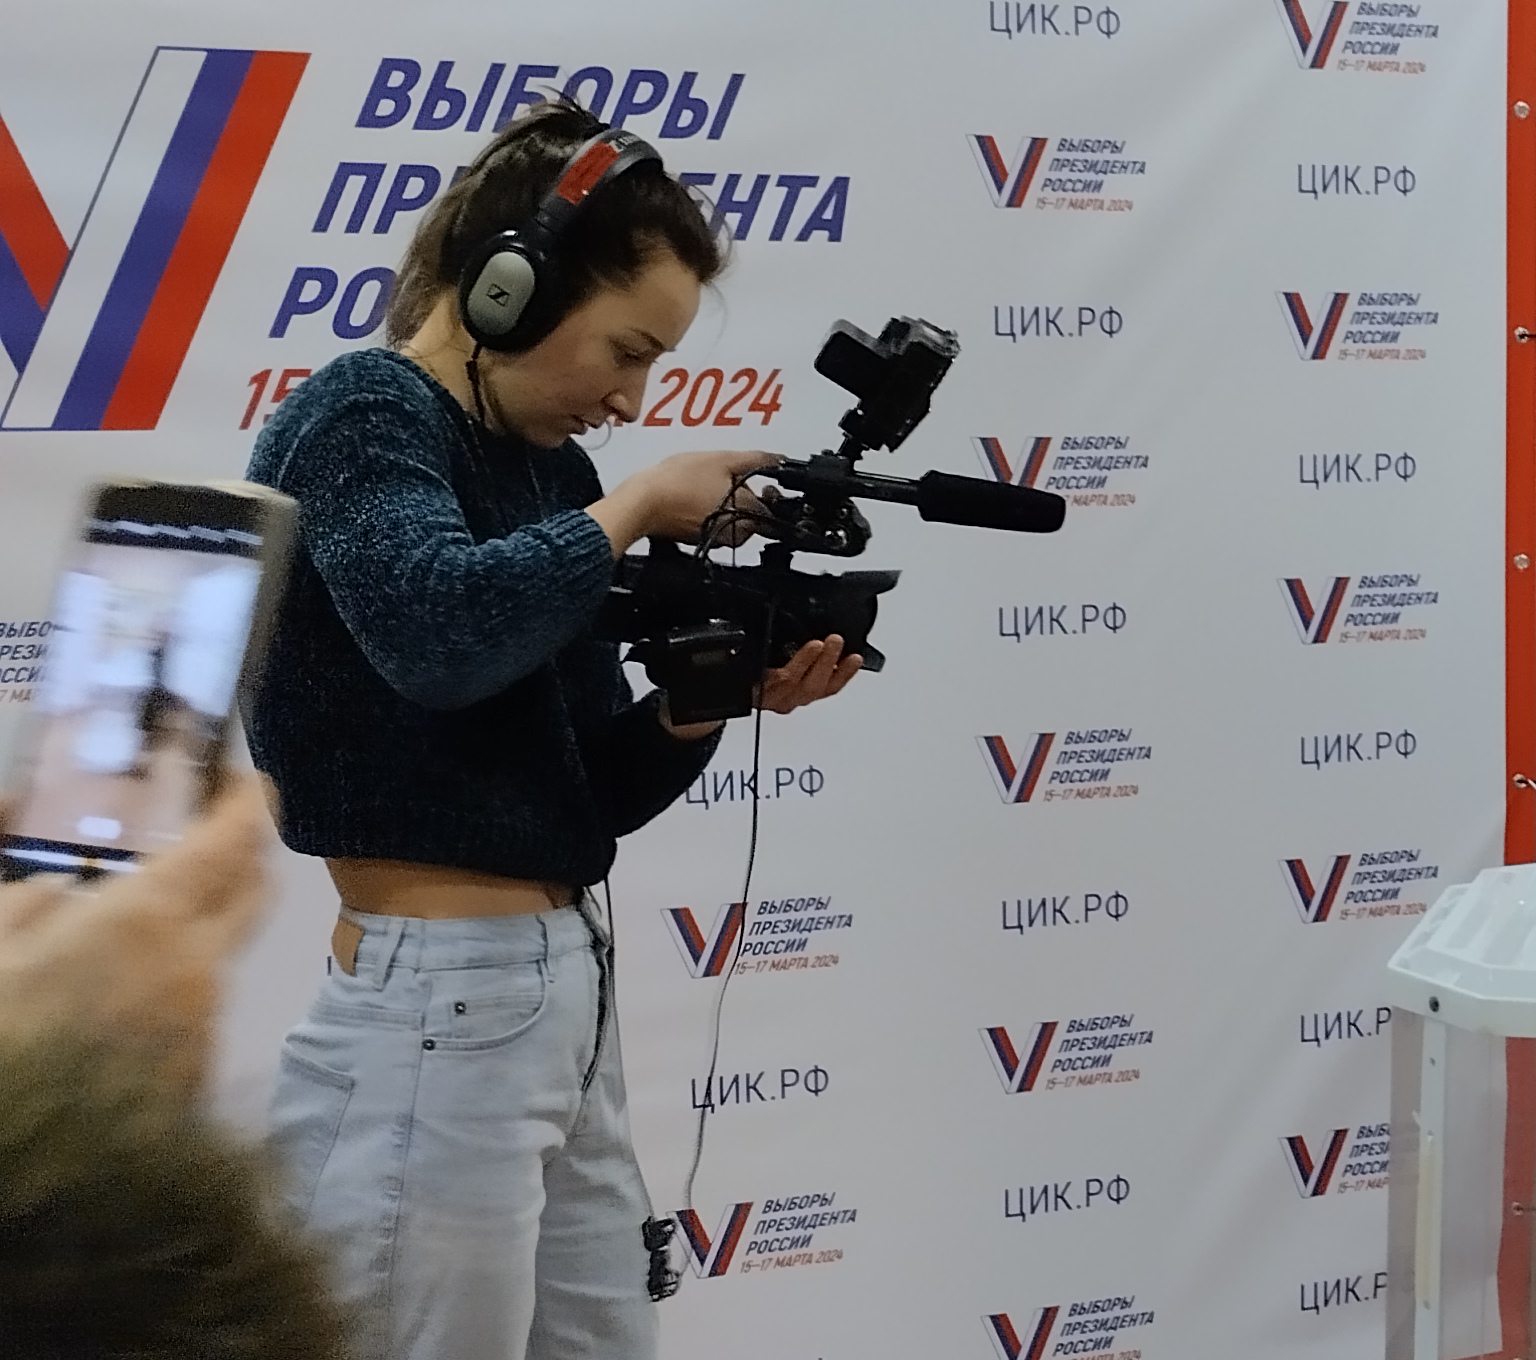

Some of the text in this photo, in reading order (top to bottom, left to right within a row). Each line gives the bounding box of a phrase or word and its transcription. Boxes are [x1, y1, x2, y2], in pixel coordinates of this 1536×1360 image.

[1357, 1, 1421, 18] ВЫБОРЫ
[990, 1, 1120, 40] ЦИК.РФ
[1348, 21, 1439, 38] ПРЕЗИДЕНТА
[1341, 40, 1400, 55] РОССИИ
[355, 58, 746, 140] ВЫБОРЫ
[1057, 138, 1126, 154] ВЫБОРЫ
[1048, 158, 1146, 175] ПРЕЗИДЕНТА
[1041, 177, 1104, 193] РОССИИ
[1298, 164, 1415, 200] ЦИК.РФ
[312, 162, 850, 242] ПРНТА
[1357, 292, 1421, 306] ВЫБОРЫ
[994, 306, 1123, 343] ЦИК.РФ
[1349, 311, 1439, 326] ПРЕЗИДЕНТА
[1342, 330, 1401, 344] РОССИИ
[643, 367, 784, 427] 2024
[1060, 436, 1130, 450] ВЫБОРЫ
[1052, 455, 1149, 471] ПРЕЗИДЕНТА
[1300, 452, 1416, 490] ЦИК.РФ
[1044, 475, 1108, 490] РОССИИ
[1358, 573, 1421, 590] ВЫБОРЫ
[1350, 591, 1439, 608] ПРЕЗИДЕНТА
[999, 602, 1126, 643] ЦИК.РФ
[1343, 612, 1401, 627] РОССИИ
[1064, 728, 1132, 745] ВЫБОРЫ
[1056, 746, 1152, 765] ПРЕЗИДЕНТА
[1301, 729, 1416, 770] ЦИК.РФ
[1048, 768, 1111, 784] РОССИИ
[685, 765, 825, 810] ЦИК.РФ
[1358, 849, 1421, 867] ВЫБОРЫ
[1351, 865, 1439, 886] ПРЕЗИДЕНТА
[757, 896, 832, 915] ВЫБОРЫ
[1344, 887, 1401, 904] РОССИИ
[1002, 891, 1128, 935] ЦИК.РФ
[748, 913, 853, 936] ПРЕЗИДЕНТА
[740, 937, 809, 957] РОССИИ
[769, 957, 809, 972] МАРТА
[810, 954, 839, 969] 2024
[1066, 1013, 1135, 1033] ВЫБОРЫ
[1301, 1007, 1391, 1047] ЦИК.Р
[1058, 1030, 1154, 1053] ПРЕЗИДЕНТА
[1051, 1053, 1113, 1073] РОССИИ
[691, 1065, 829, 1114] ЦИК.РФ
[1356, 1123, 1390, 1139] ВЫБ
[1342, 1160, 1389, 1177] РОССИ
[762, 1192, 836, 1214] ВЫБОРЫ
[1005, 1174, 1130, 1222] ЦИК.РФ
[753, 1209, 857, 1235] ПРЕЗИДЕНТА
[745, 1233, 813, 1256] РОССИИ
[773, 1253, 813, 1269] МАРТА
[815, 1249, 844, 1264] 2024
[1301, 1272, 1387, 1315] ЦИК.Р
[1068, 1295, 1135, 1318] ВЫБОРЫ
[1060, 1311, 1155, 1337] ПРЕЗИДЕНТА
[1052, 1336, 1114, 1357] РОССИИ
